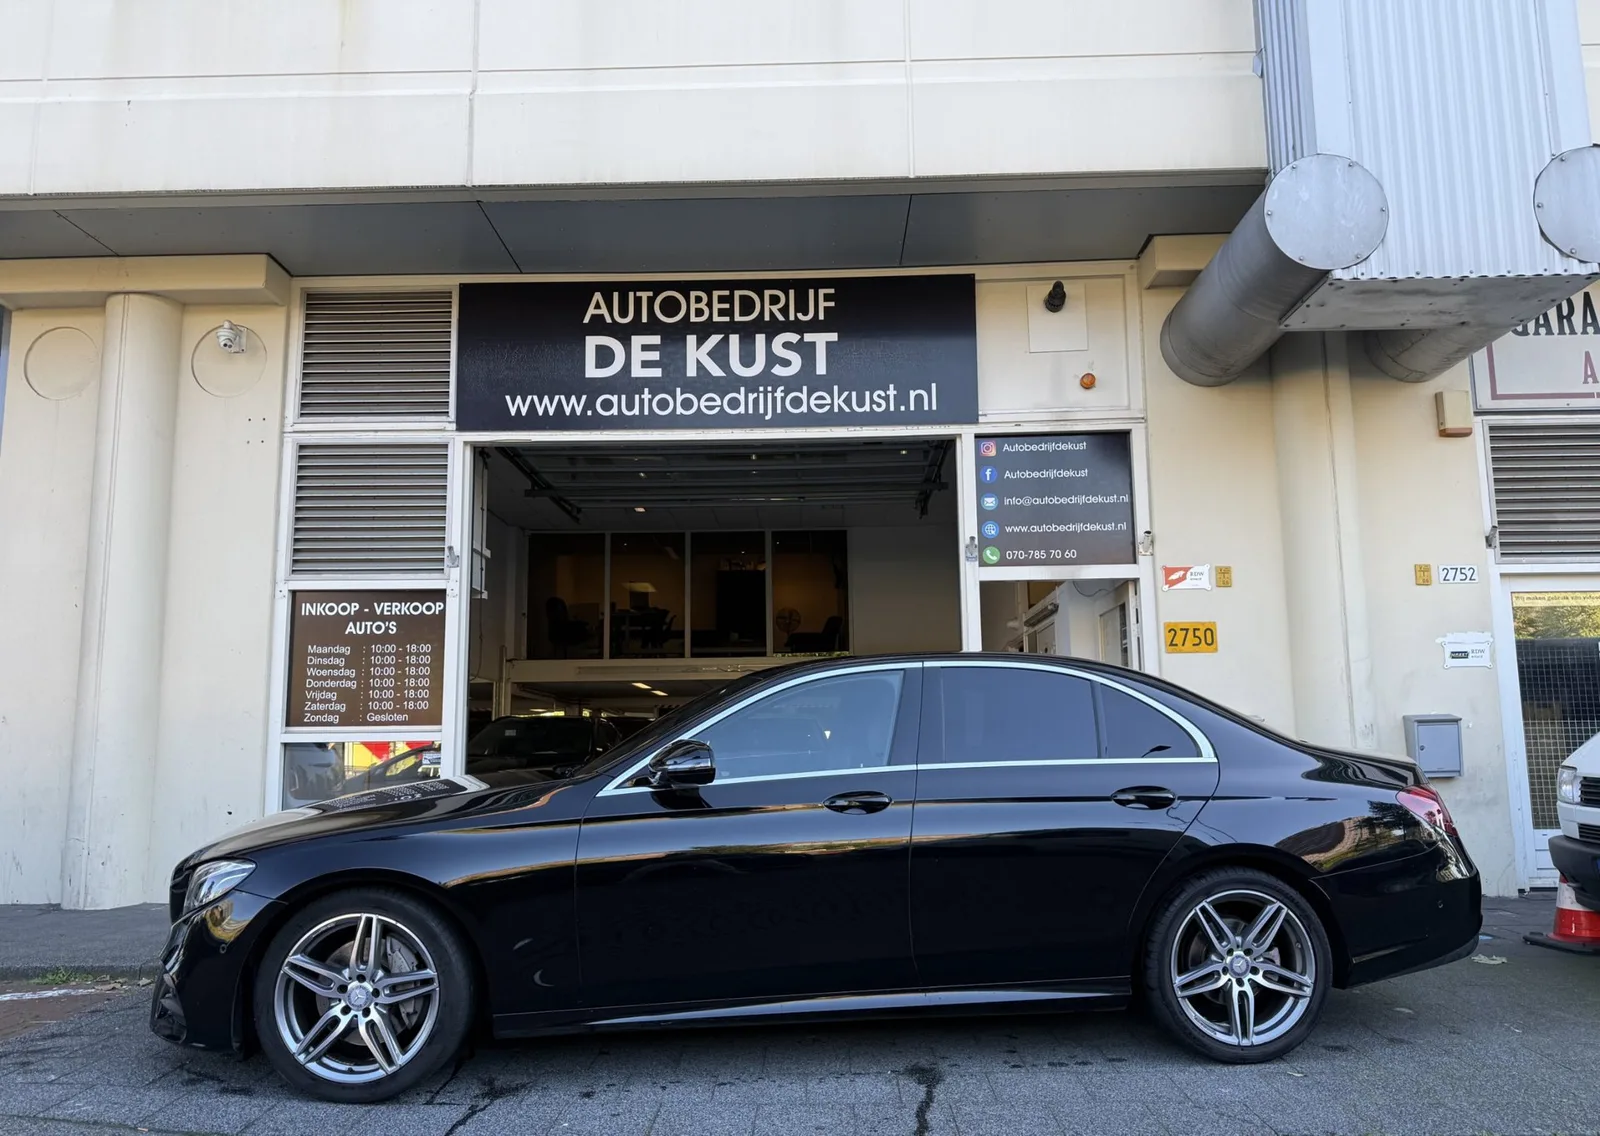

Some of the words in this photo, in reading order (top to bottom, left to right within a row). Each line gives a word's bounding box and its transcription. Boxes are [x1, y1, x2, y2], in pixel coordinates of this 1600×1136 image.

[583, 288, 836, 324] AUTOBEDRIJF
[584, 334, 662, 378] DE
[686, 332, 838, 377] KUST
[505, 383, 938, 420] www.autobedrijfdekust.nl
[1003, 441, 1087, 453] Autobedrijfdekust
[1004, 468, 1088, 480] Autobedrijfdekust
[1005, 522, 1127, 533] www.autobedrijfdekust.nl
[1006, 550, 1047, 560] 070-785
[1050, 550, 1062, 559] 70
[1064, 549, 1077, 559] 60
[1442, 567, 1476, 582] 2752
[301, 603, 360, 616] INKOOP
[374, 602, 444, 615] VERKOOP
[345, 621, 397, 635] AUTO'S
[1168, 627, 1215, 647] 2750
[308, 645, 351, 655] Maandag
[370, 644, 396, 653] 10:00
[405, 644, 431, 653] 18:00
[307, 656, 345, 666] Dinsdag
[370, 656, 396, 664] 10:00
[405, 655, 431, 664] 18:00
[306, 667, 356, 678] Woensdag
[369, 667, 395, 676] 10:00
[405, 667, 430, 675] 18:00
[306, 679, 357, 689] Donderdag
[369, 678, 395, 687] 10:00
[404, 678, 430, 687] 18:00
[305, 690, 337, 700] Vrijdag
[368, 690, 394, 699] 10:00
[403, 689, 429, 698] 18:00
[304, 701, 346, 711] Zaterdag
[367, 701, 394, 710] 10:00
[403, 701, 429, 710] 18:00
[304, 713, 339, 723] Zondag
[366, 712, 409, 722] Gesloten
